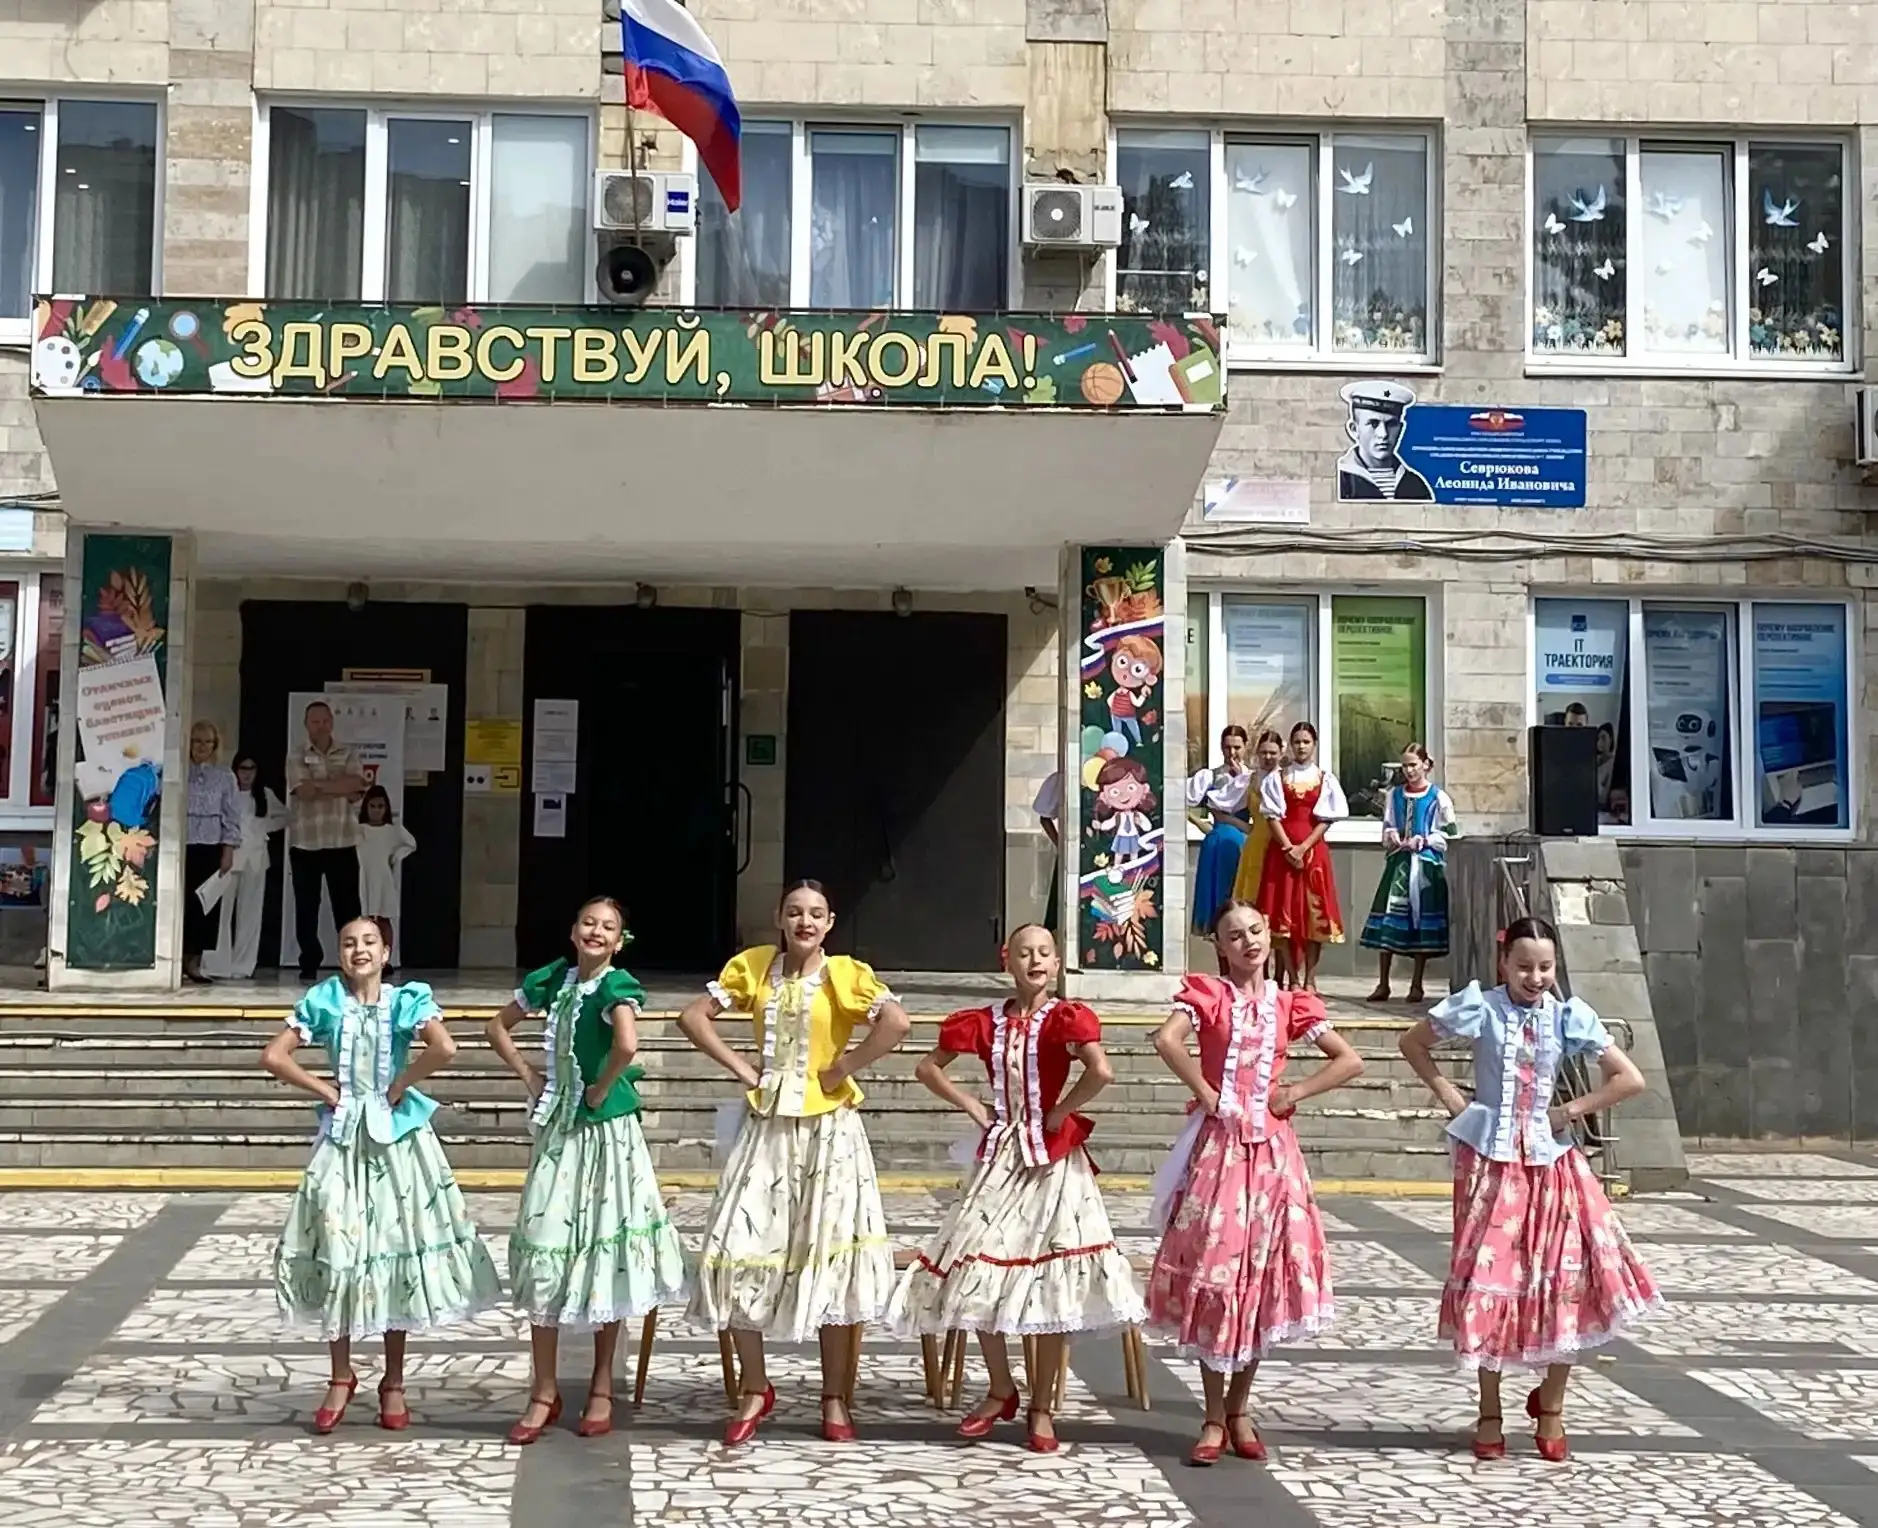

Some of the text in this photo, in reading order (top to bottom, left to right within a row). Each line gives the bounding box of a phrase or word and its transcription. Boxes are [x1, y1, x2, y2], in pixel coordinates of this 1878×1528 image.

[229, 315, 1037, 396] ЗДРАВСТВУЙ, ШКОЛА!
[1459, 460, 1540, 477] Севрюкова
[1435, 476, 1576, 492] Леонида Ивановича
[1544, 653, 1613, 668] ТРАЕКТОРИЯ
[81, 675, 153, 697] Отличных
